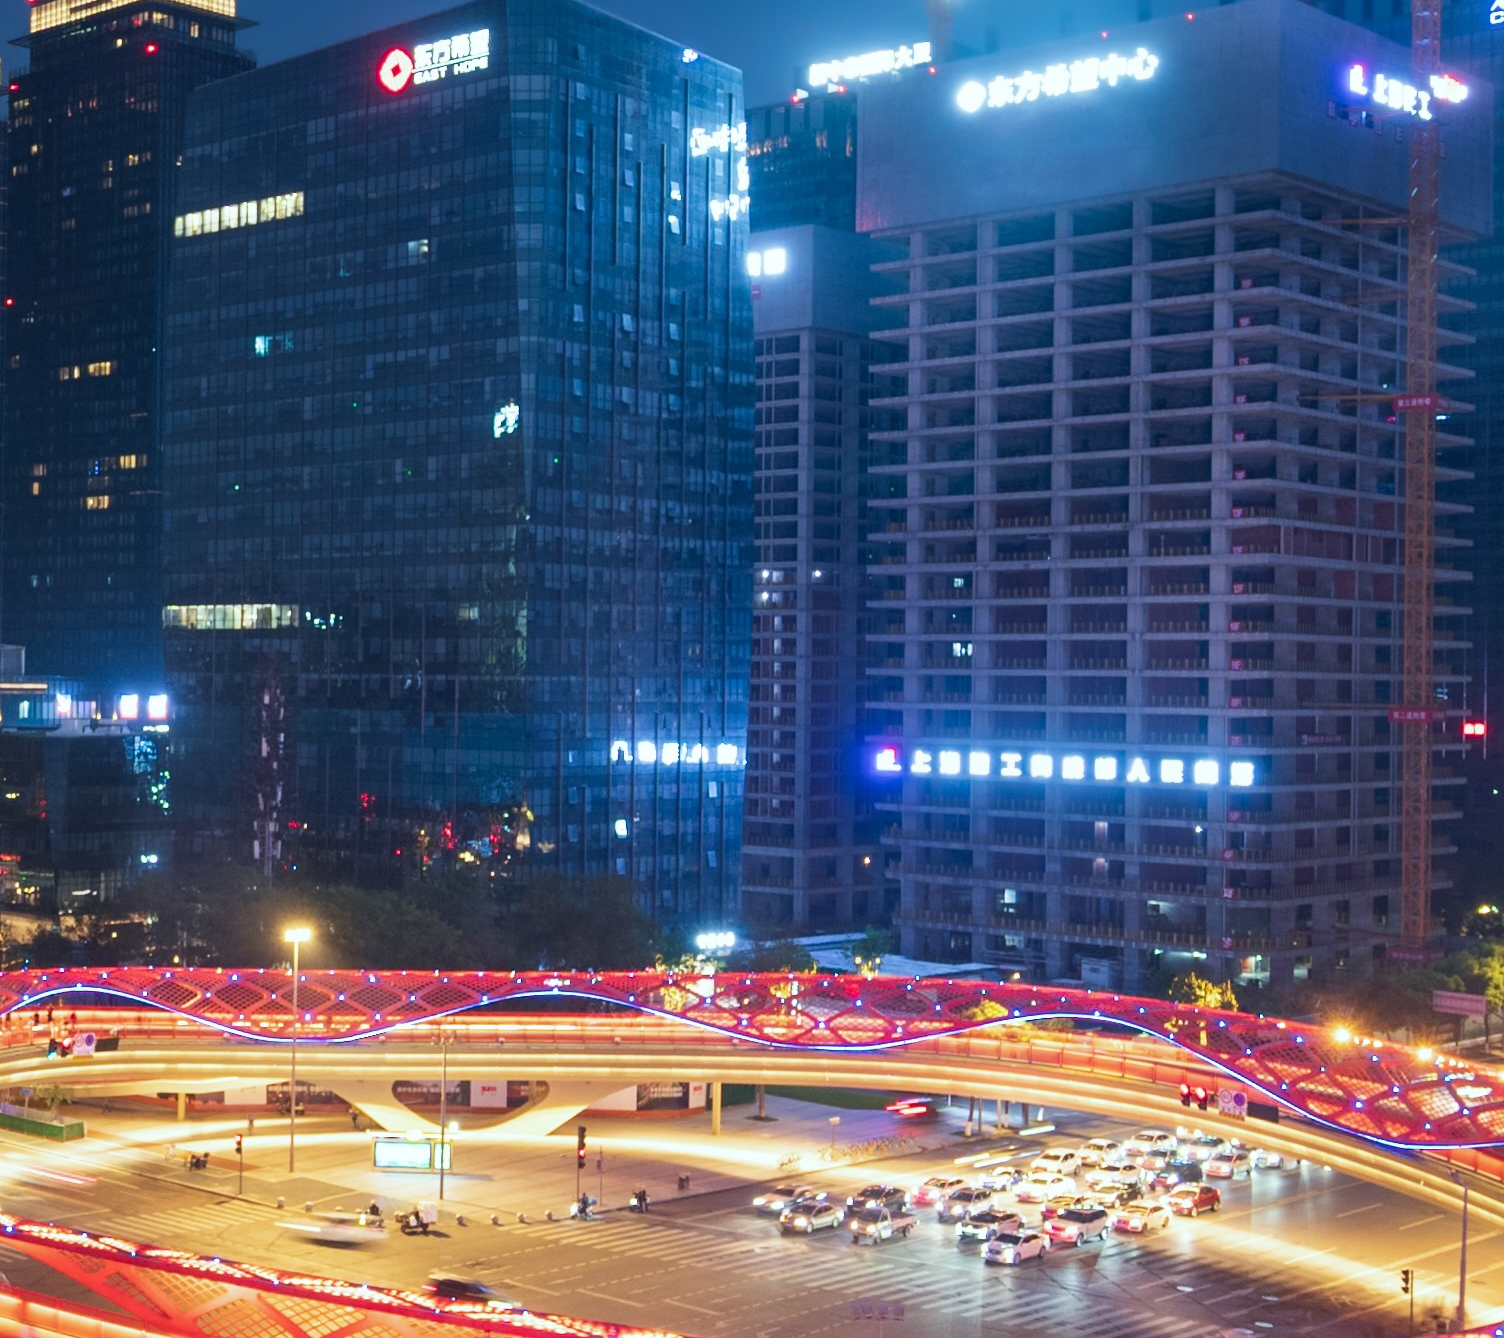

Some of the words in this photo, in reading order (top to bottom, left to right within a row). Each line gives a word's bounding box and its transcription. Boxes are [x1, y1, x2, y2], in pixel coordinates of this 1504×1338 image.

[413, 66, 447, 85] EAST
[454, 56, 489, 75] HOPE
[987, 47, 1159, 108] 东方希望中心
